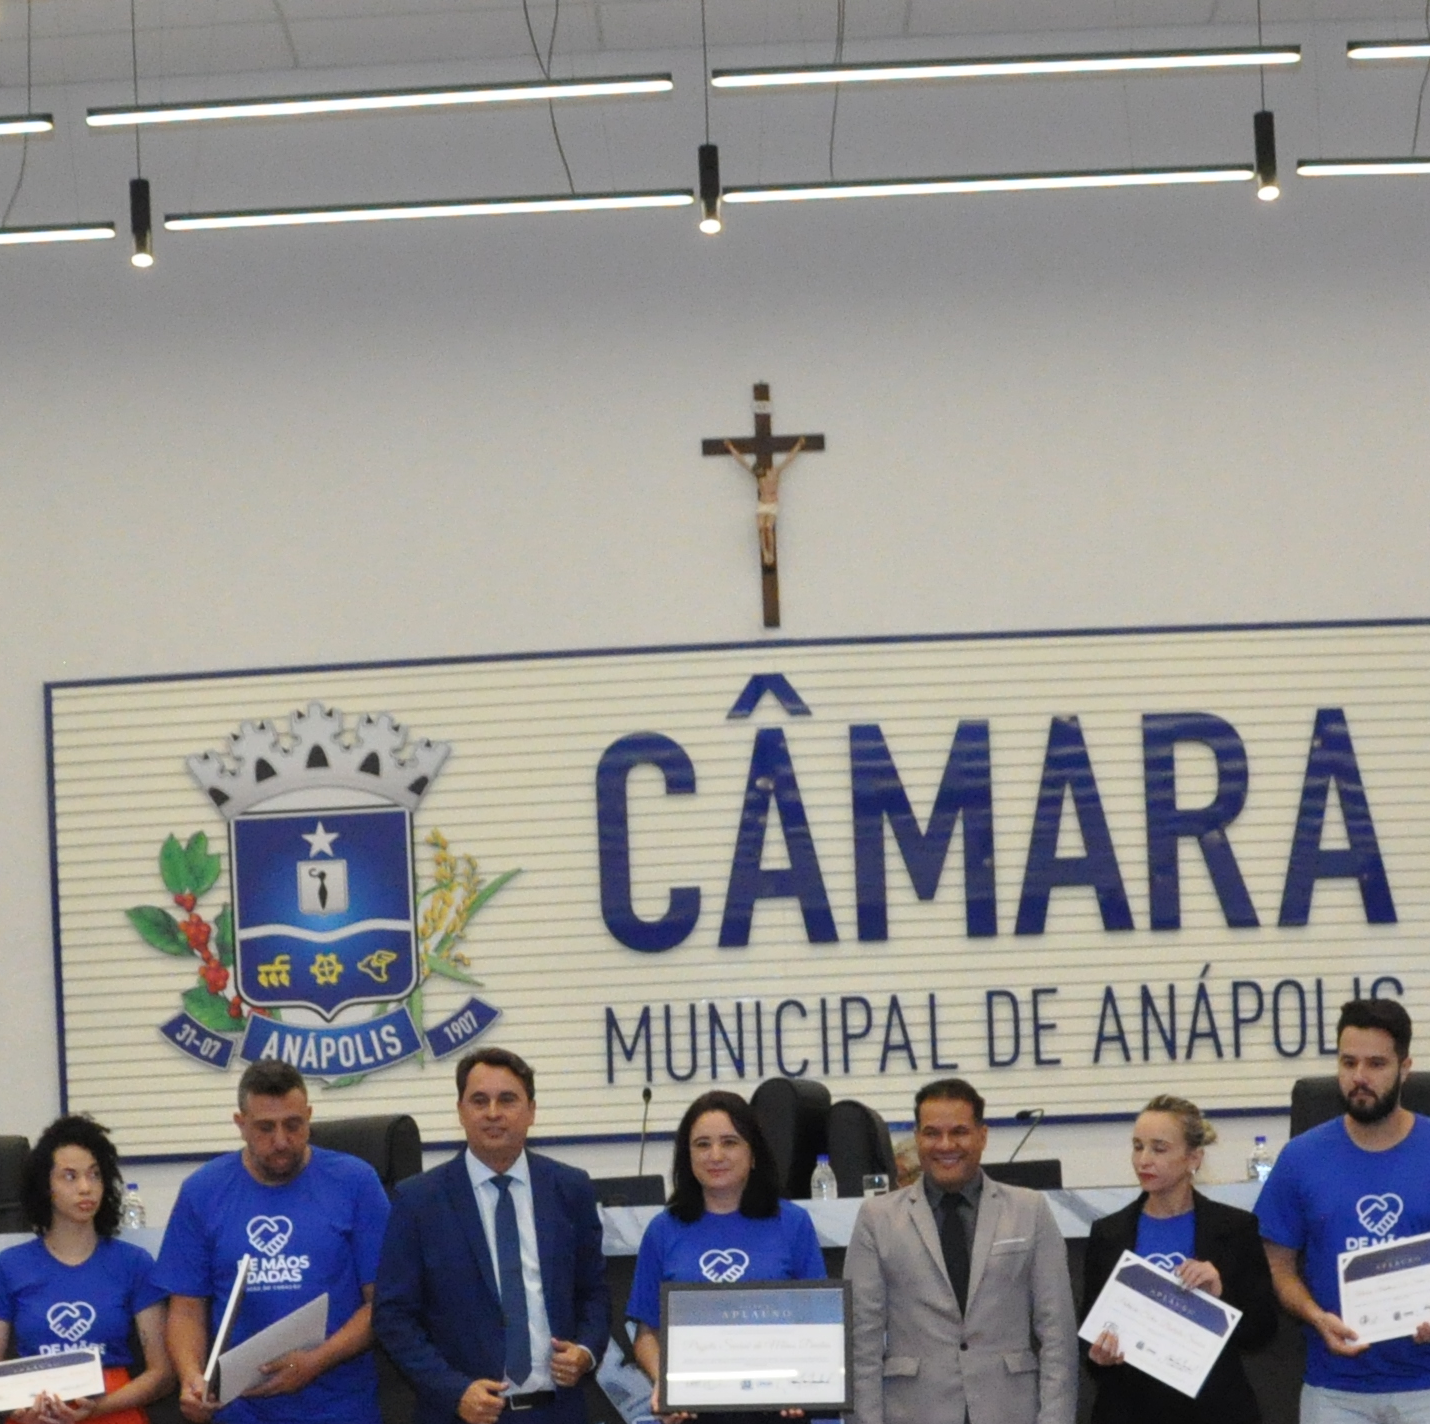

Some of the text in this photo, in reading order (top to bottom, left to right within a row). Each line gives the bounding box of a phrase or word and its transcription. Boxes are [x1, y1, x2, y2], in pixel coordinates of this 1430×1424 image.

[595, 673, 1398, 953] CÂMARA
[443, 1011, 480, 1045] 1907
[605, 963, 1405, 1084] MUNICIPAL DE ANÁPOL
[175, 1023, 222, 1060] 31-07
[260, 1024, 403, 1069] ANÁPOLIS
[1346, 1237, 1369, 1250] DE
[246, 1268, 302, 1284] DADAS
[261, 1254, 310, 1270] MÃOS
[39, 1338, 60, 1355] DE
